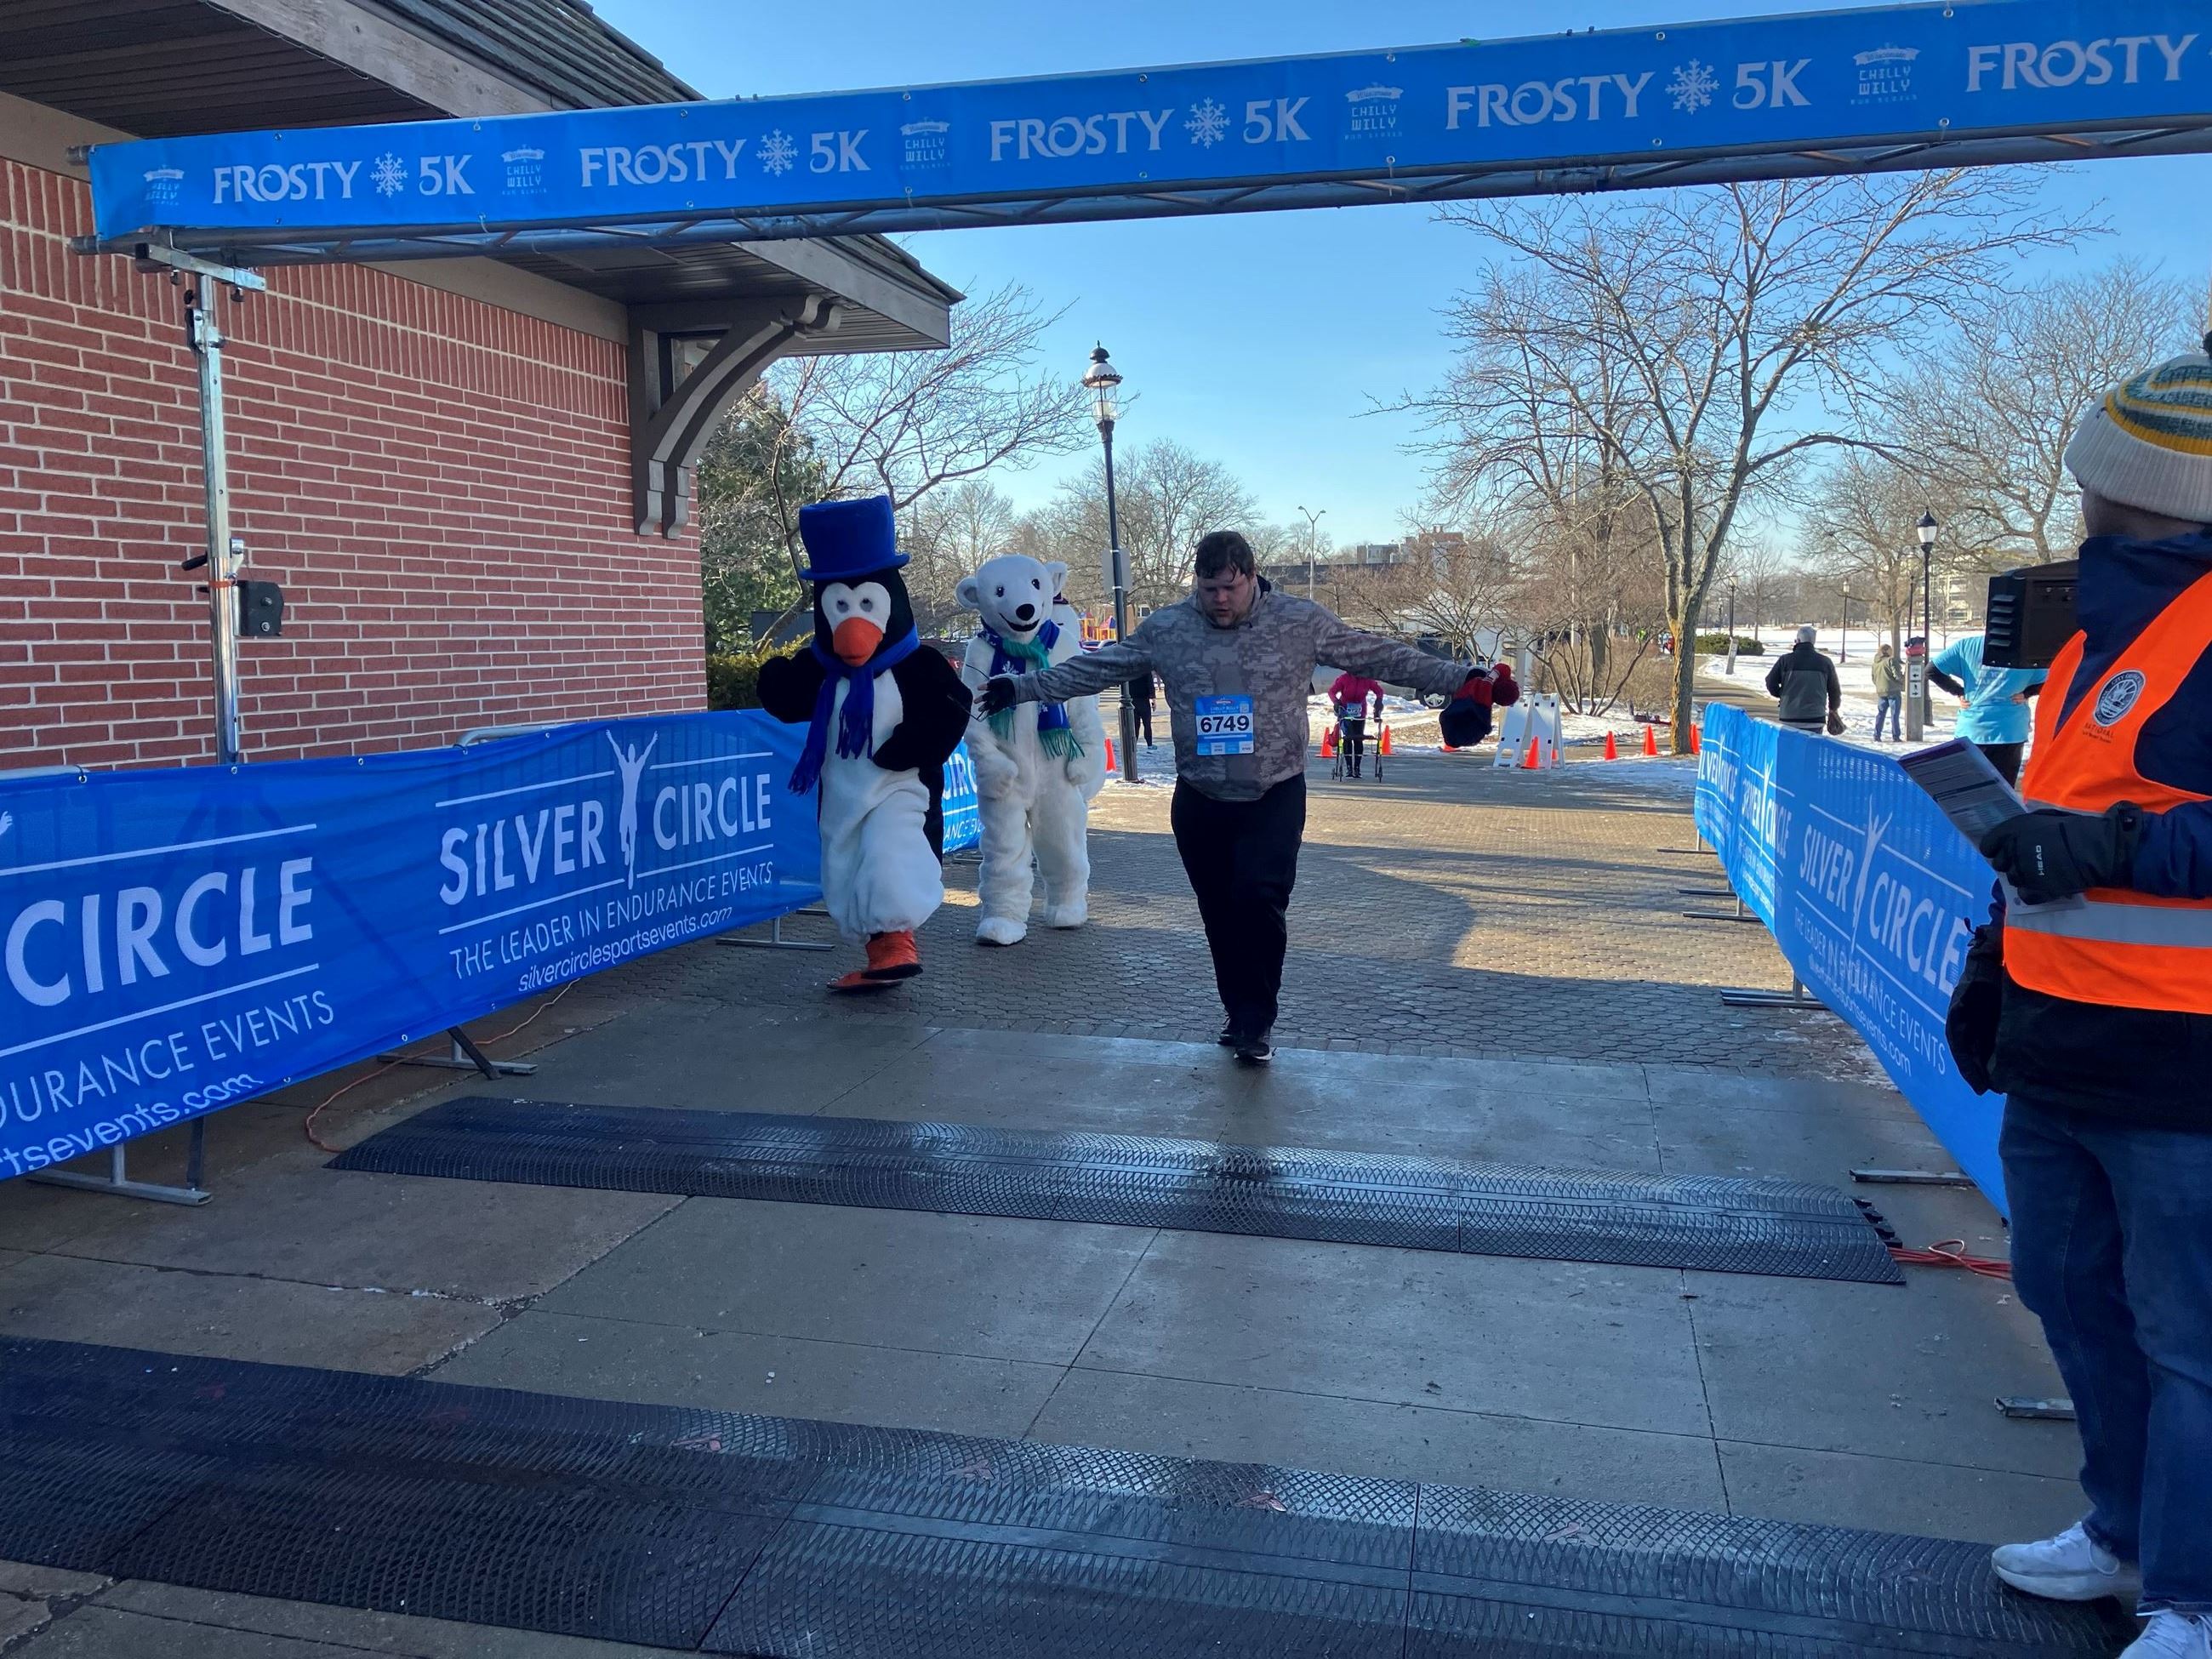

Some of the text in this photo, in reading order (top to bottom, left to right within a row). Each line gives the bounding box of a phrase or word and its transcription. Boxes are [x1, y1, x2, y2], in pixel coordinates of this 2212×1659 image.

[1859, 66, 1911, 80] CHILLY
[1859, 79, 1911, 95] WILLY
[1965, 33, 2199, 92] FROSTY
[1351, 104, 1397, 117] CHILLY
[1445, 58, 1813, 130] FROSTY 5K
[905, 137, 945, 149] CHILLY
[989, 96, 1313, 162] FROSTY 5K
[1351, 117, 1396, 130] WILLY
[213, 154, 476, 203] FROSTY 5K
[507, 164, 541, 175] CHILLY
[507, 175, 541, 187] WILLY
[579, 129, 872, 187] FROSTY 5K
[905, 149, 944, 162] WILLY
[1200, 715, 1250, 733] 6749
[439, 773, 771, 906] SILVER CIRCLE
[5, 857, 314, 1006] CIRCLE
[450, 861, 774, 980] THE LEADER IN ENDURANCE EVENTS
[1800, 824, 1854, 912] SILVER
[1870, 872, 1969, 998] CIRCLE
[518, 904, 733, 993] silvercirclesportsevents.com
[202, 990, 334, 1061] EVENTS
[1804, 921, 1827, 961] LEADER
[1900, 1007, 1946, 1075] EVENTS
